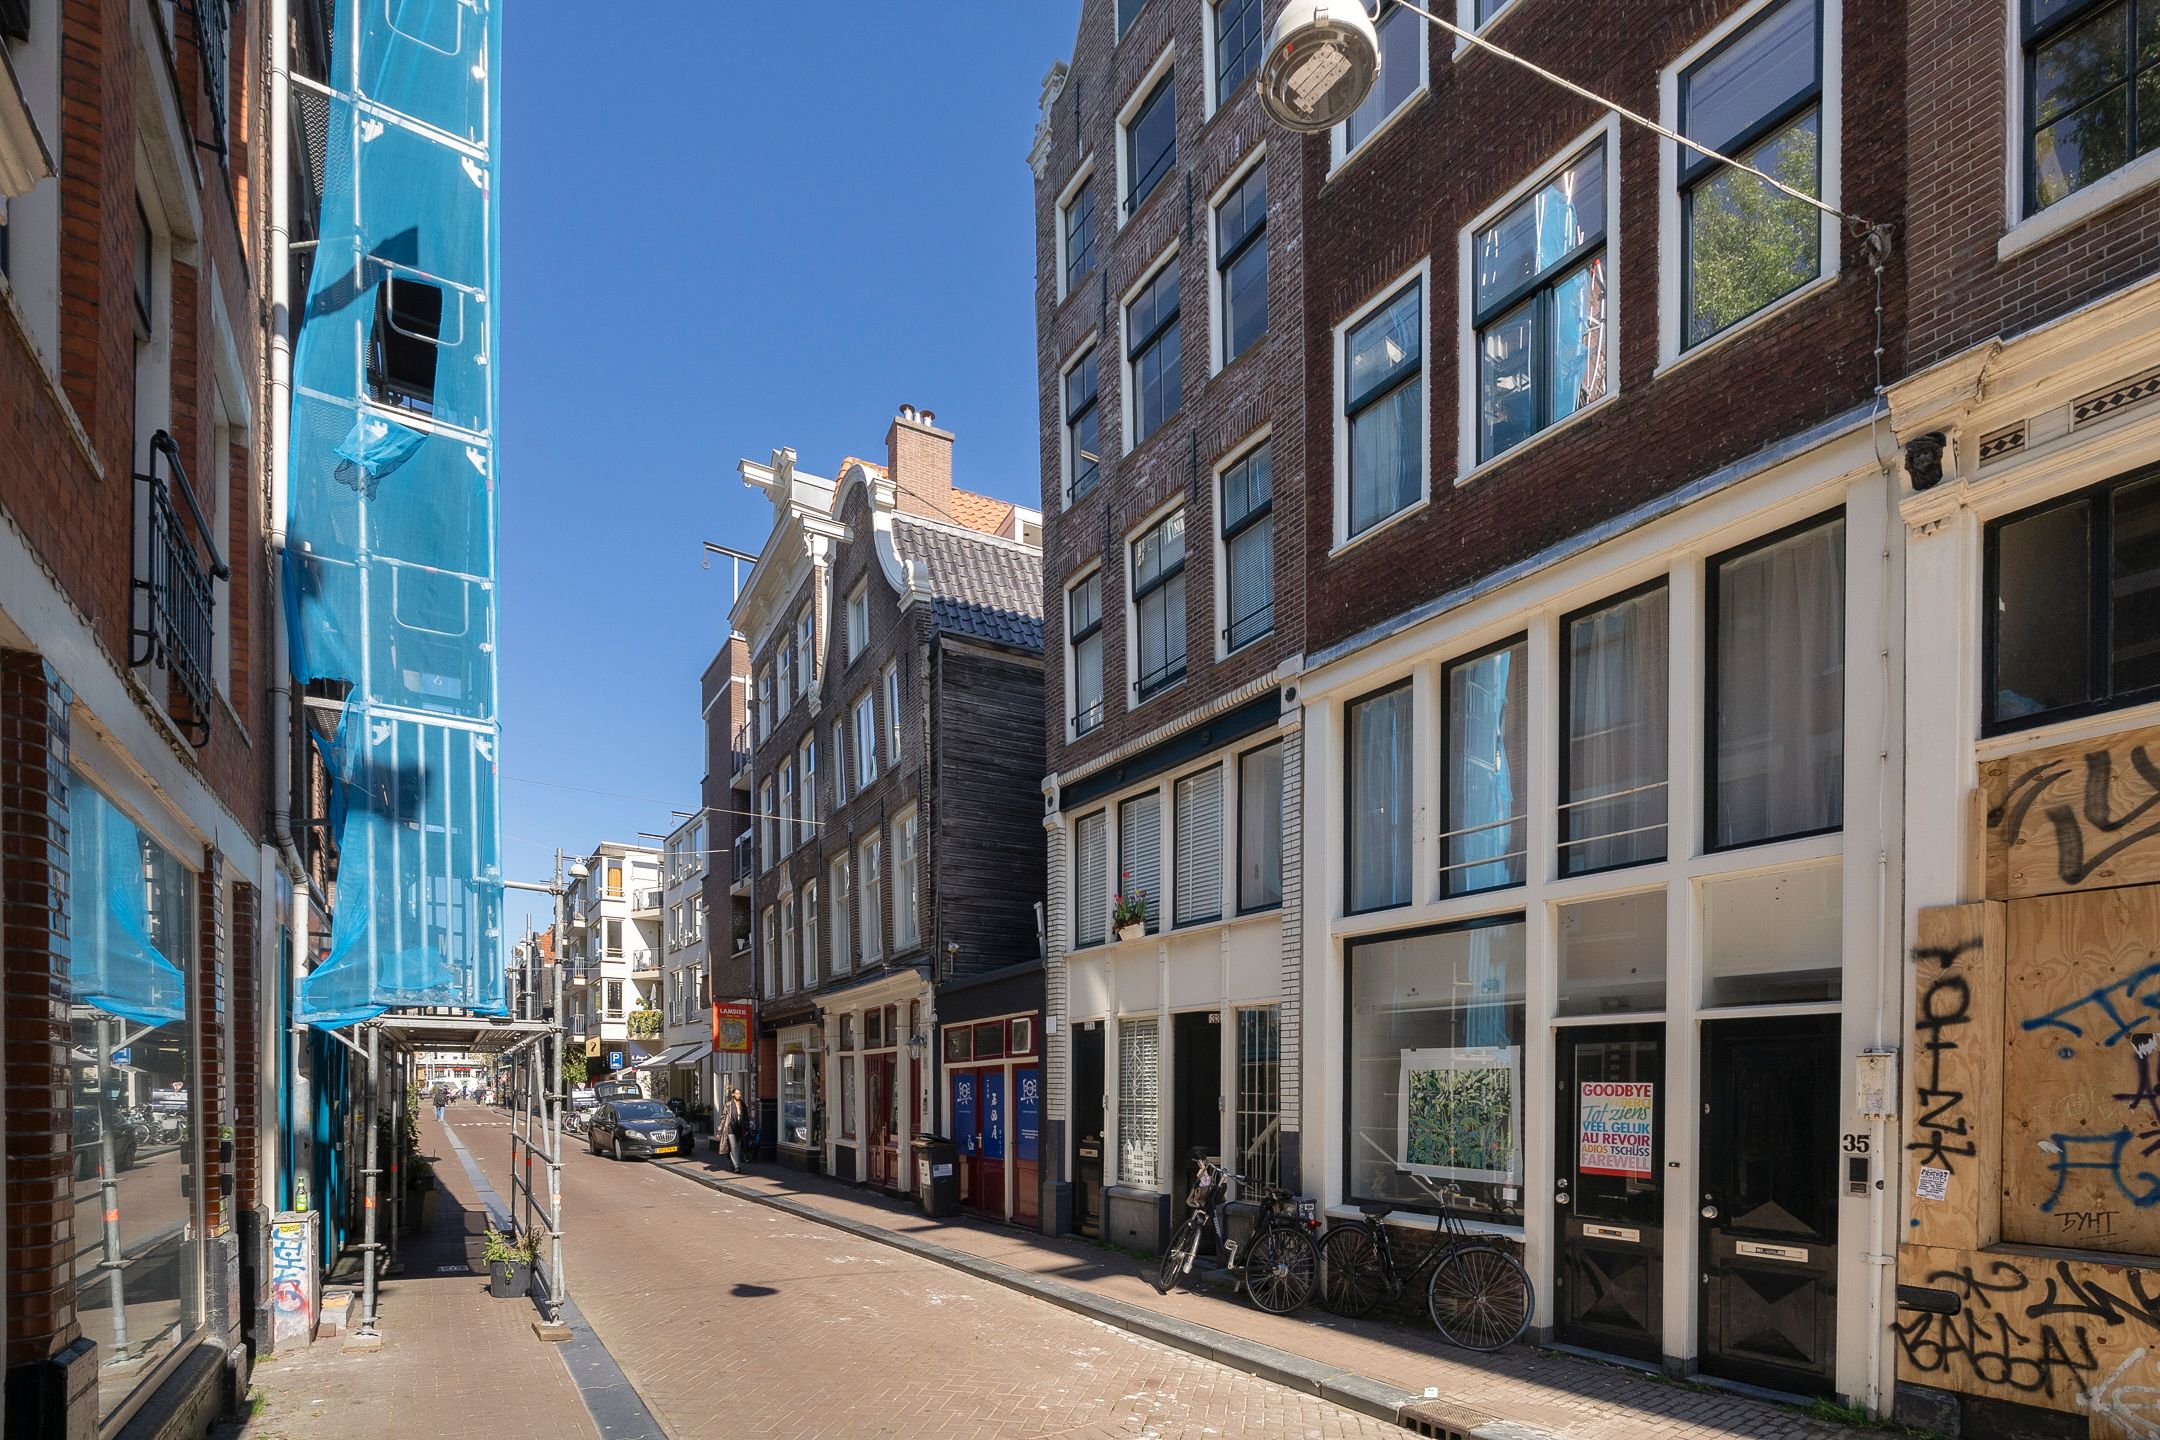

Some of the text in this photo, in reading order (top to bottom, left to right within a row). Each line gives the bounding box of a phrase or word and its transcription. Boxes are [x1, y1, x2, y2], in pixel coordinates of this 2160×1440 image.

[612, 1053, 620, 1062] P
[1583, 1084, 1651, 1097] GOODBYE
[1582, 1103, 1650, 1121] Tot ziens
[1583, 1121, 1650, 1134] VEEL GELUK
[1582, 1132, 1650, 1146] AU REVOIR
[1843, 1133, 1869, 1153] 35
[1582, 1144, 1650, 1156] ADIOS TSCHÜSS
[1581, 1153, 1650, 1169] FAREWELL
